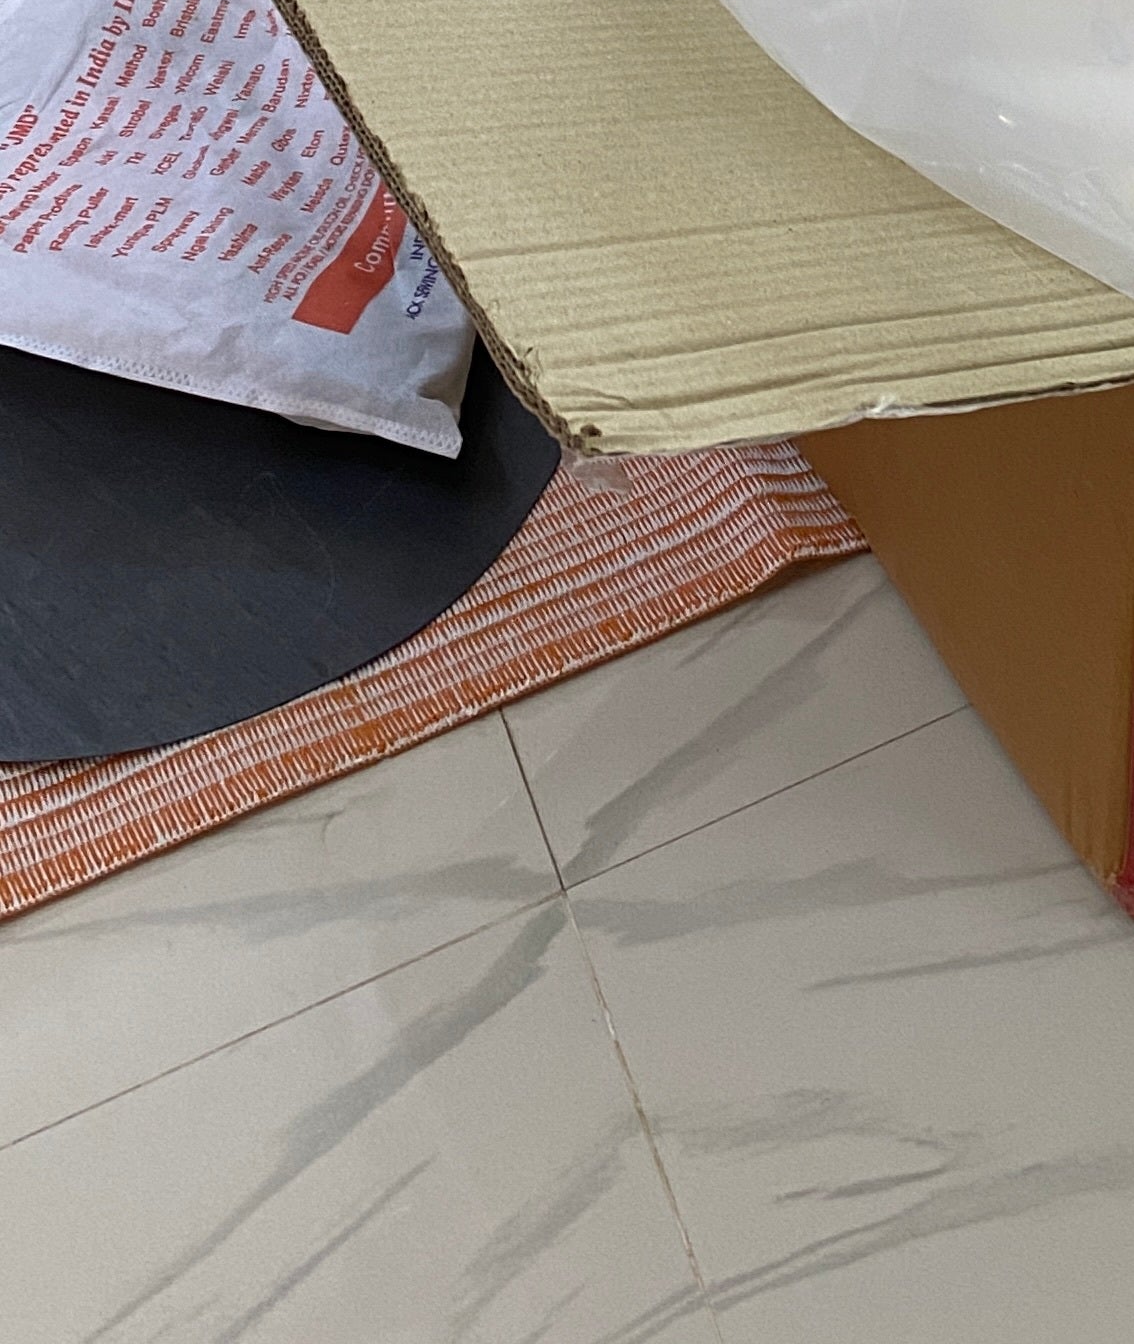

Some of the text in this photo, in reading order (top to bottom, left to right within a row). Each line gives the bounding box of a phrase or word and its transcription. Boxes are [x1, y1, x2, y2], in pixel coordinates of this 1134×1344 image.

[102, 15, 131, 38] by
[76, 39, 117, 89] India
[115, 44, 149, 88] Method
[65, 90, 91, 107] in
[261, 59, 291, 113] Barudan
[119, 100, 153, 138] Strobel
[145, 197, 174, 222] PLM
[231, 63, 266, 102] Yamato
[301, 129, 326, 158] Eton
[151, 151, 183, 175] XCEL
[78, 187, 109, 219] Puller
